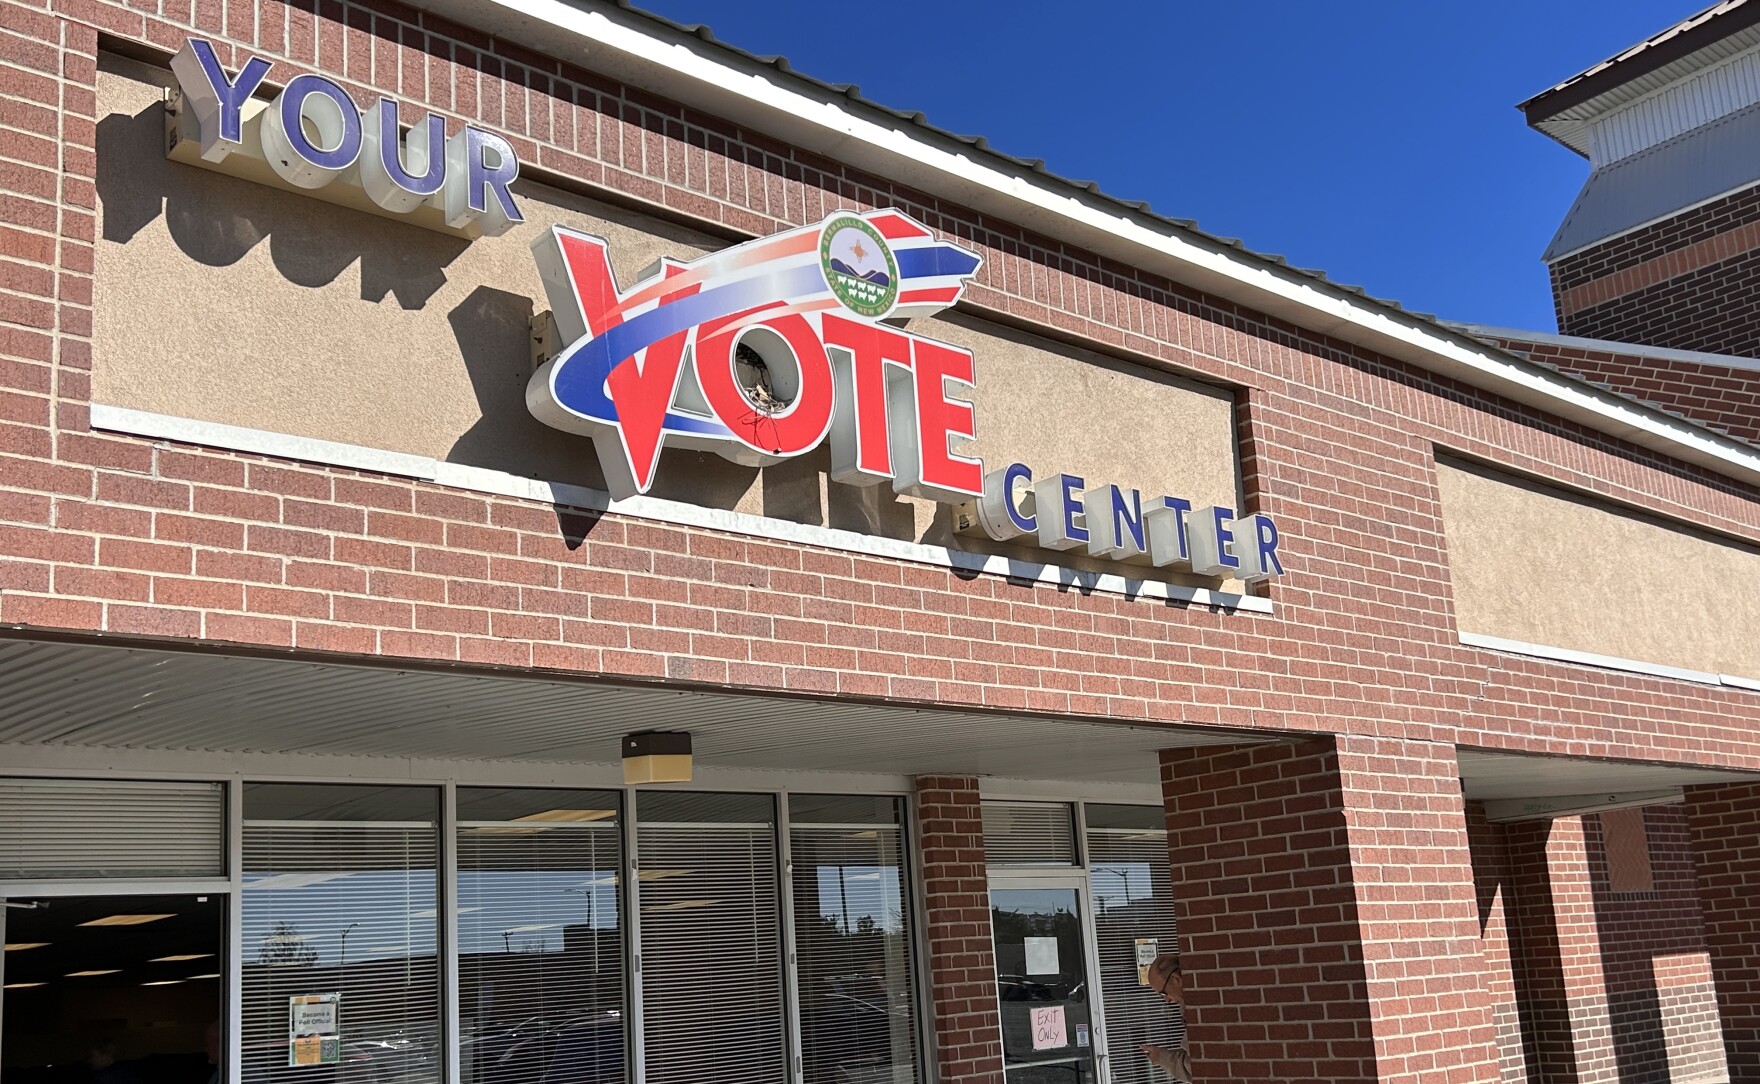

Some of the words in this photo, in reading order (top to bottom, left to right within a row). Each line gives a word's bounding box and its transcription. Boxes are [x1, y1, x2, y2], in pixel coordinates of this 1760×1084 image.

[186, 37, 525, 222] YOUR
[823, 218, 864, 247] BERNALILLO
[867, 228, 894, 267] COUNTY
[824, 267, 843, 299] STATE
[844, 298, 854, 309] OF
[857, 306, 875, 316] NEW
[876, 287, 897, 315] MEXICO
[555, 225, 986, 496] VOTE
[1003, 462, 1285, 577] CENTER
[1037, 1009, 1059, 1026] EXIT
[1037, 1026, 1060, 1044] ONLY
